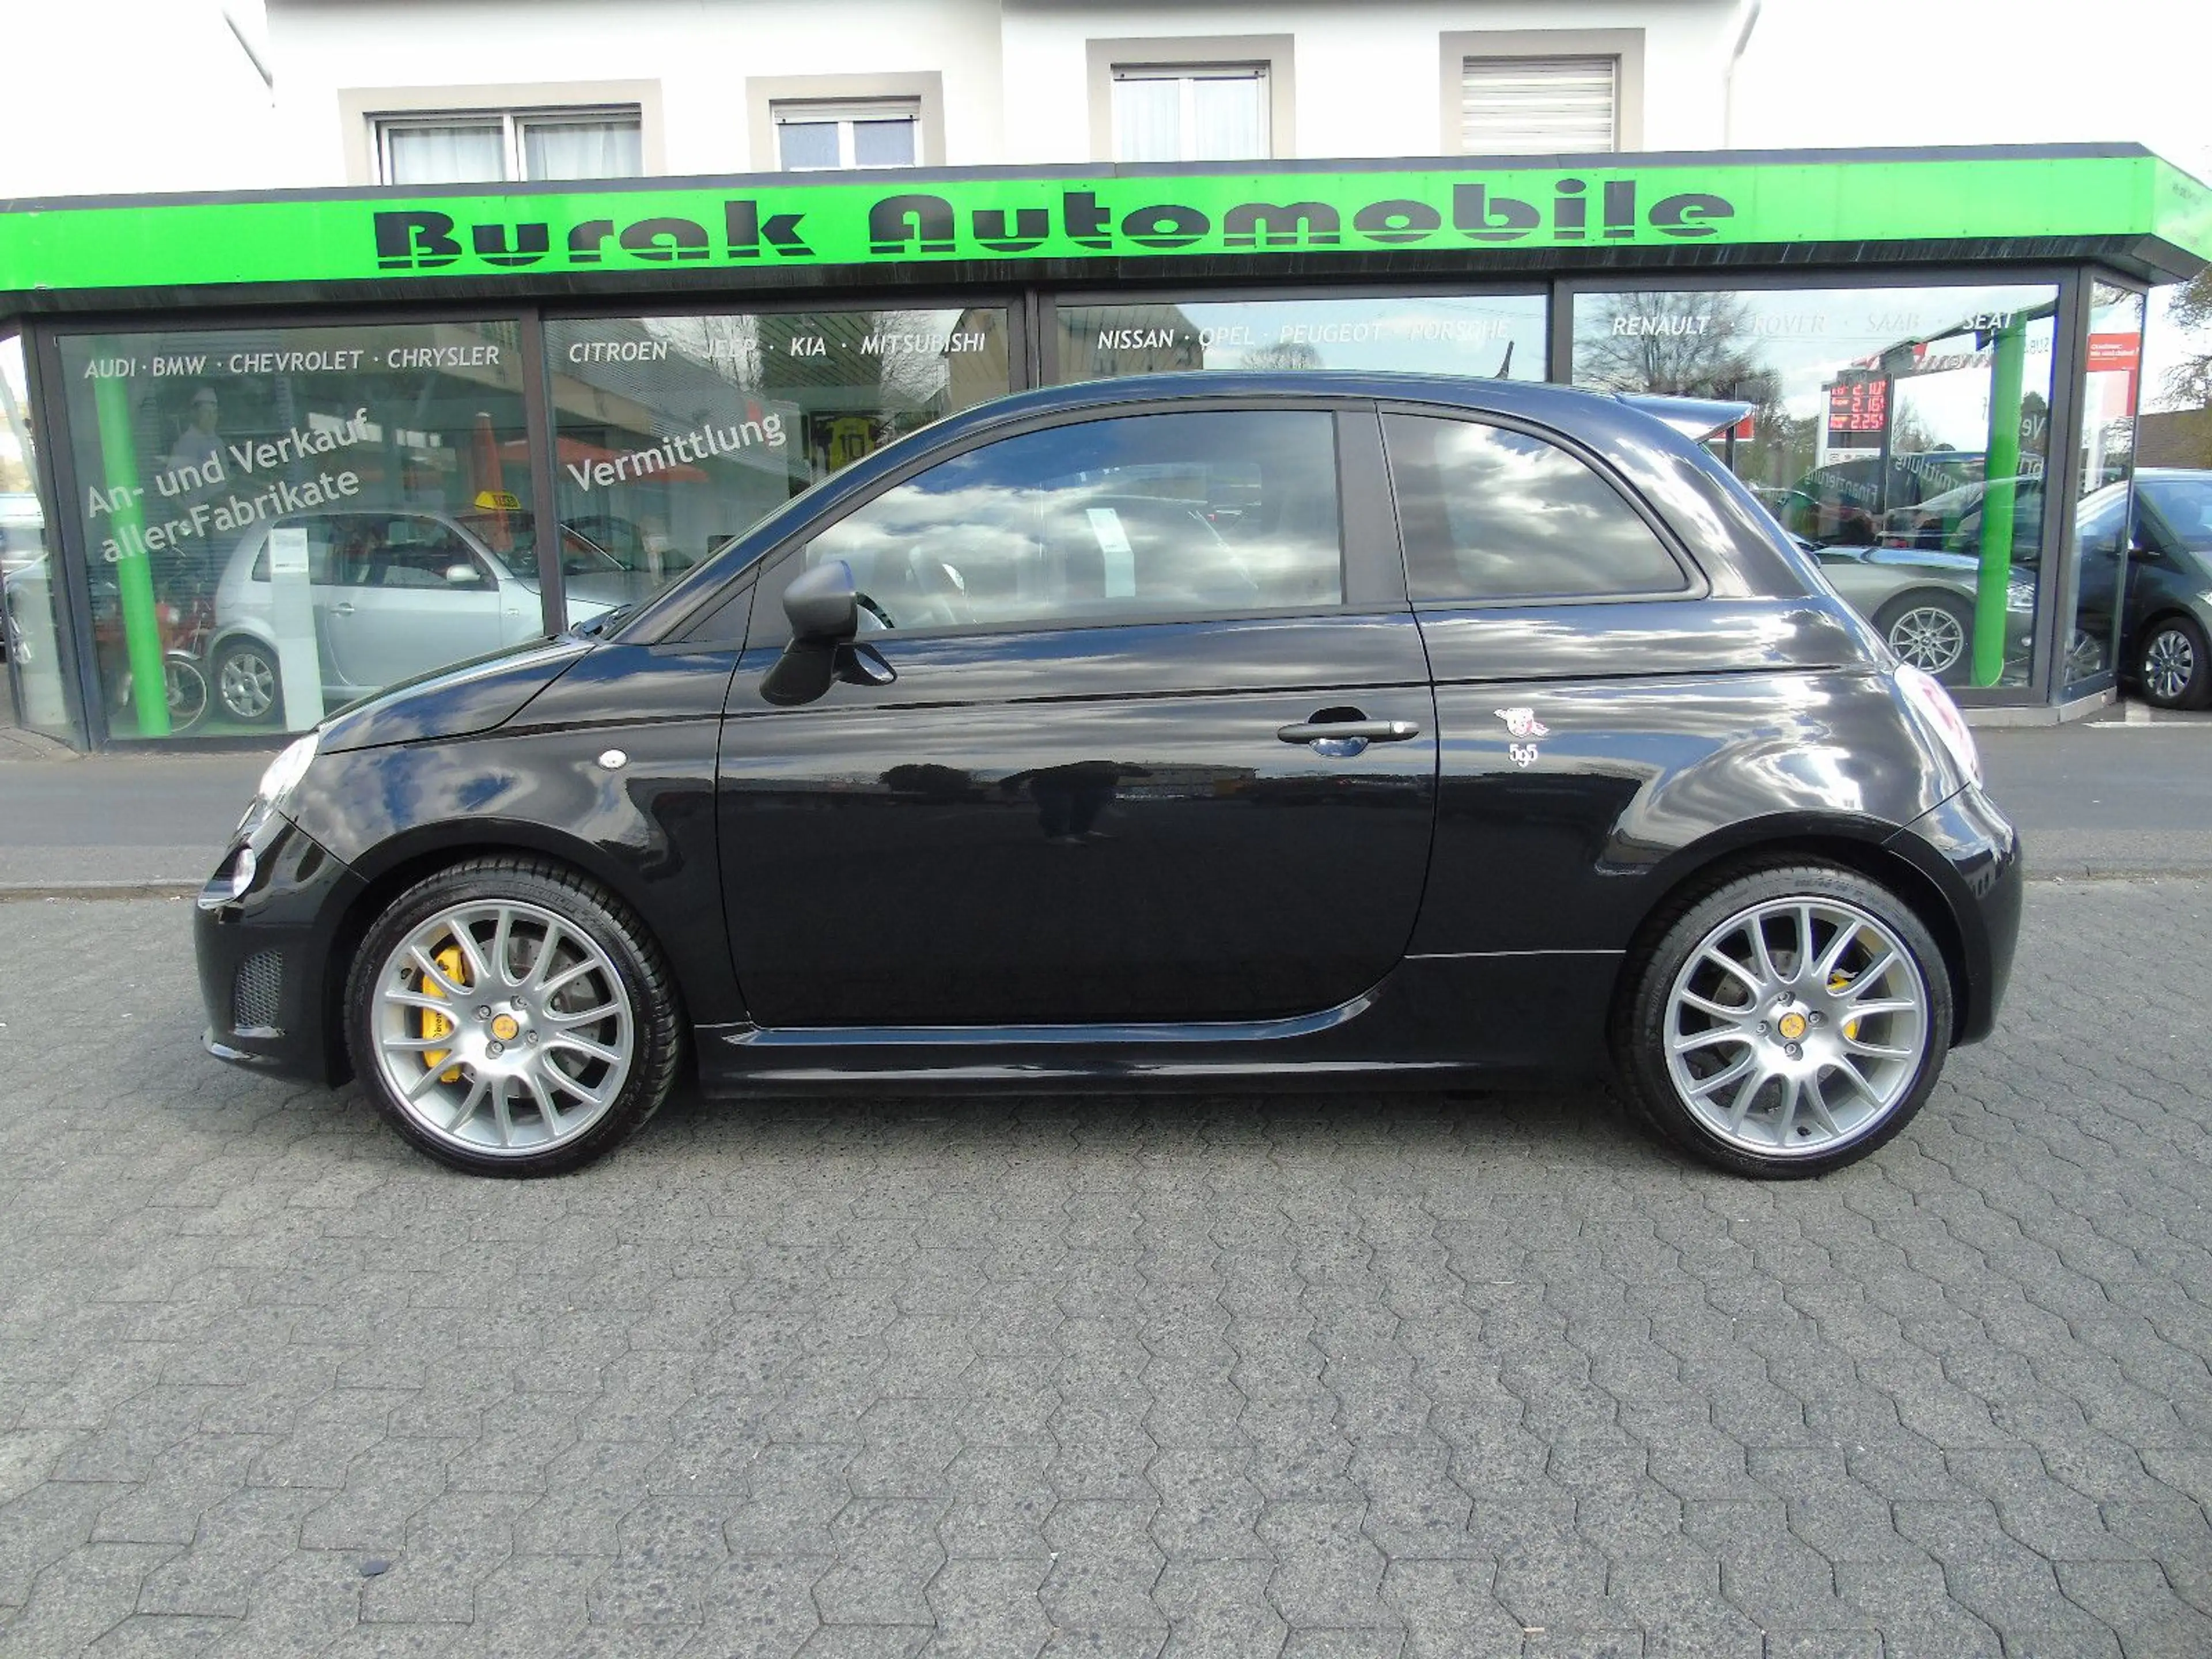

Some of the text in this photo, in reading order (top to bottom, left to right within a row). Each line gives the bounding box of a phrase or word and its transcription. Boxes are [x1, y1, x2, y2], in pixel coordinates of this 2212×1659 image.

[374, 179, 1735, 270] Burak Automobile
[569, 332, 985, 363] CITROEN JEEP KIA MITSUBISHI
[1098, 319, 1512, 350] NISSAN OPEL PEUGEOT PORSCHE
[1613, 312, 2014, 336] RENAULT ROVER SAAB SEAT
[85, 346, 500, 379] AUDI BMW CHEVROLET CHRYSLER
[88, 407, 368, 518] An- und Verkauf
[566, 412, 786, 493] Vermittlung
[101, 467, 361, 563] aller Fabrikate
